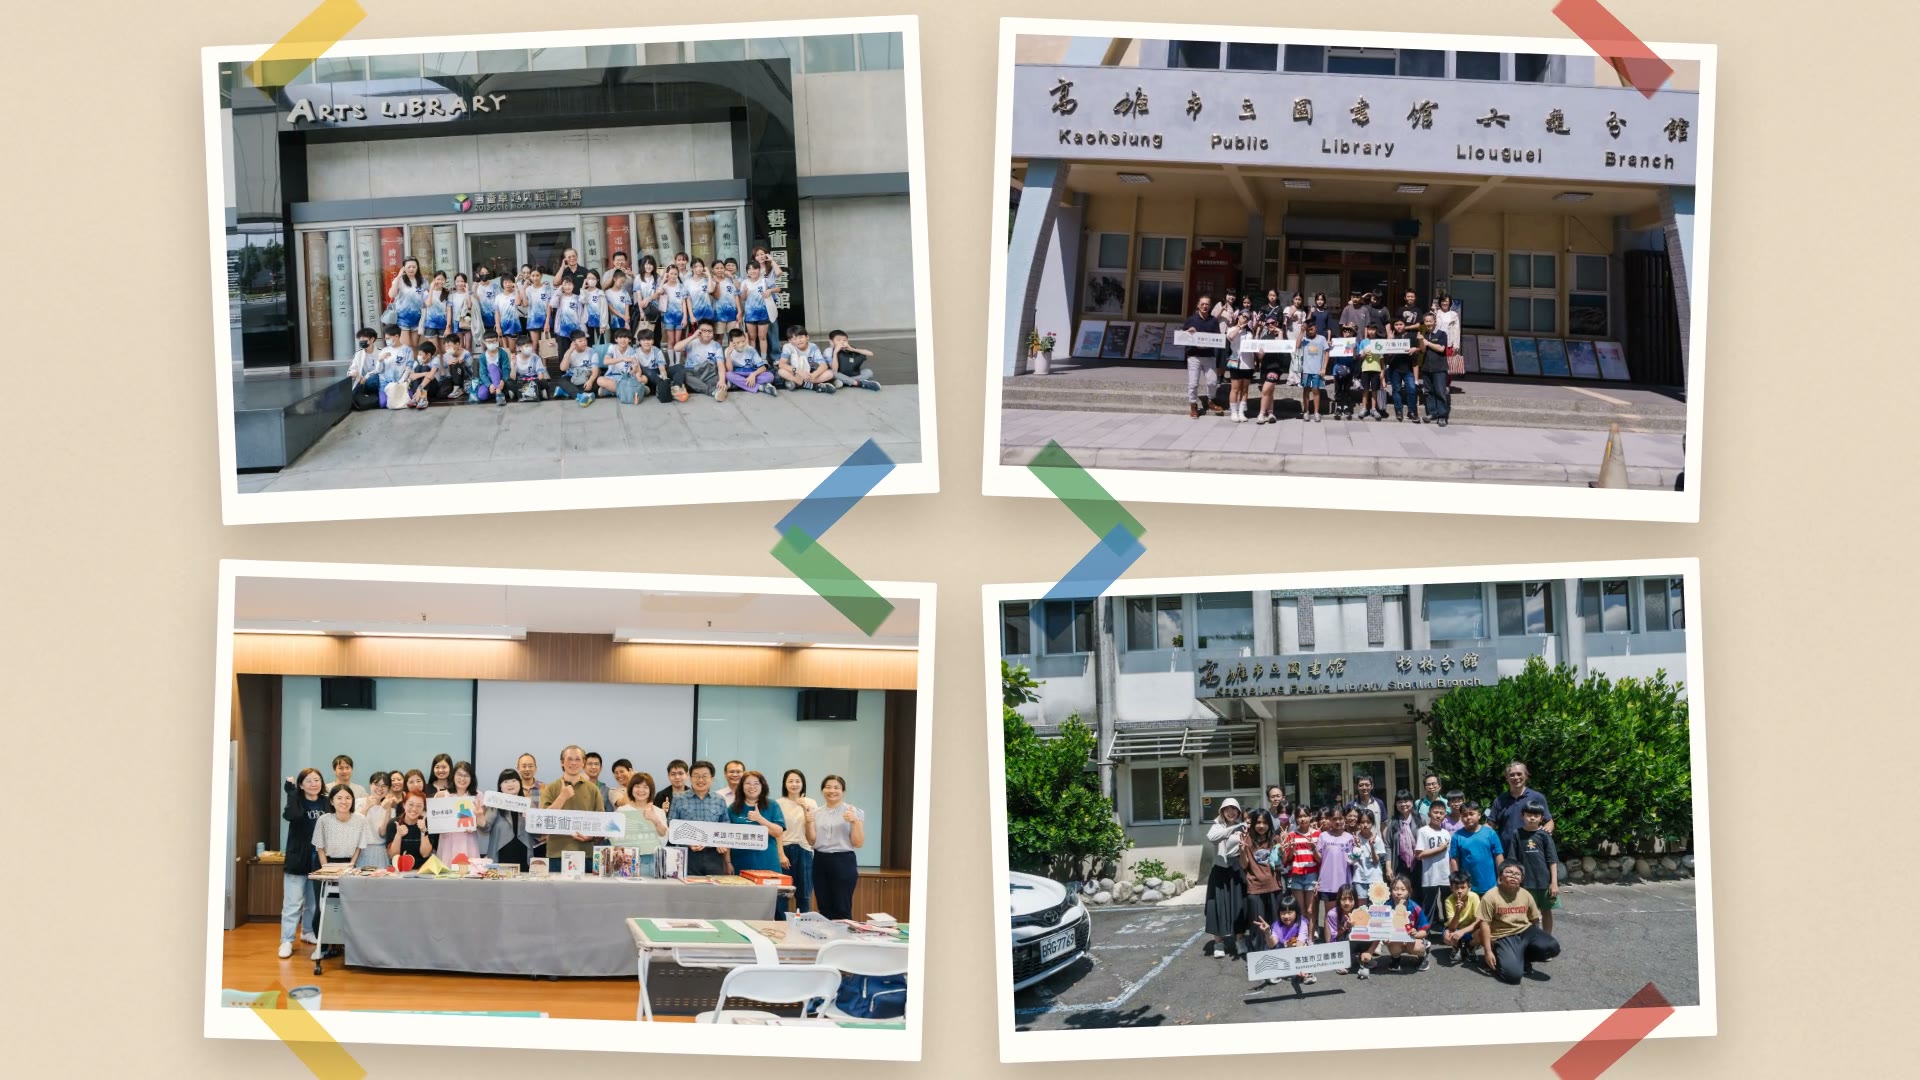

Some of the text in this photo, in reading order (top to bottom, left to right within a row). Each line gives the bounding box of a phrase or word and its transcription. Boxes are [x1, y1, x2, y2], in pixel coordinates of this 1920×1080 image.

[381, 94, 506, 118] LIBRARY
[1059, 129, 1675, 170] Kaohsiung Public Library Liouguei Branch
[1199, 652, 1480, 687] 高雄市立圖書館 杉林分館
[1290, 684, 1330, 694] Public
[1336, 681, 1383, 693] Library
[1437, 677, 1481, 689] Branch
